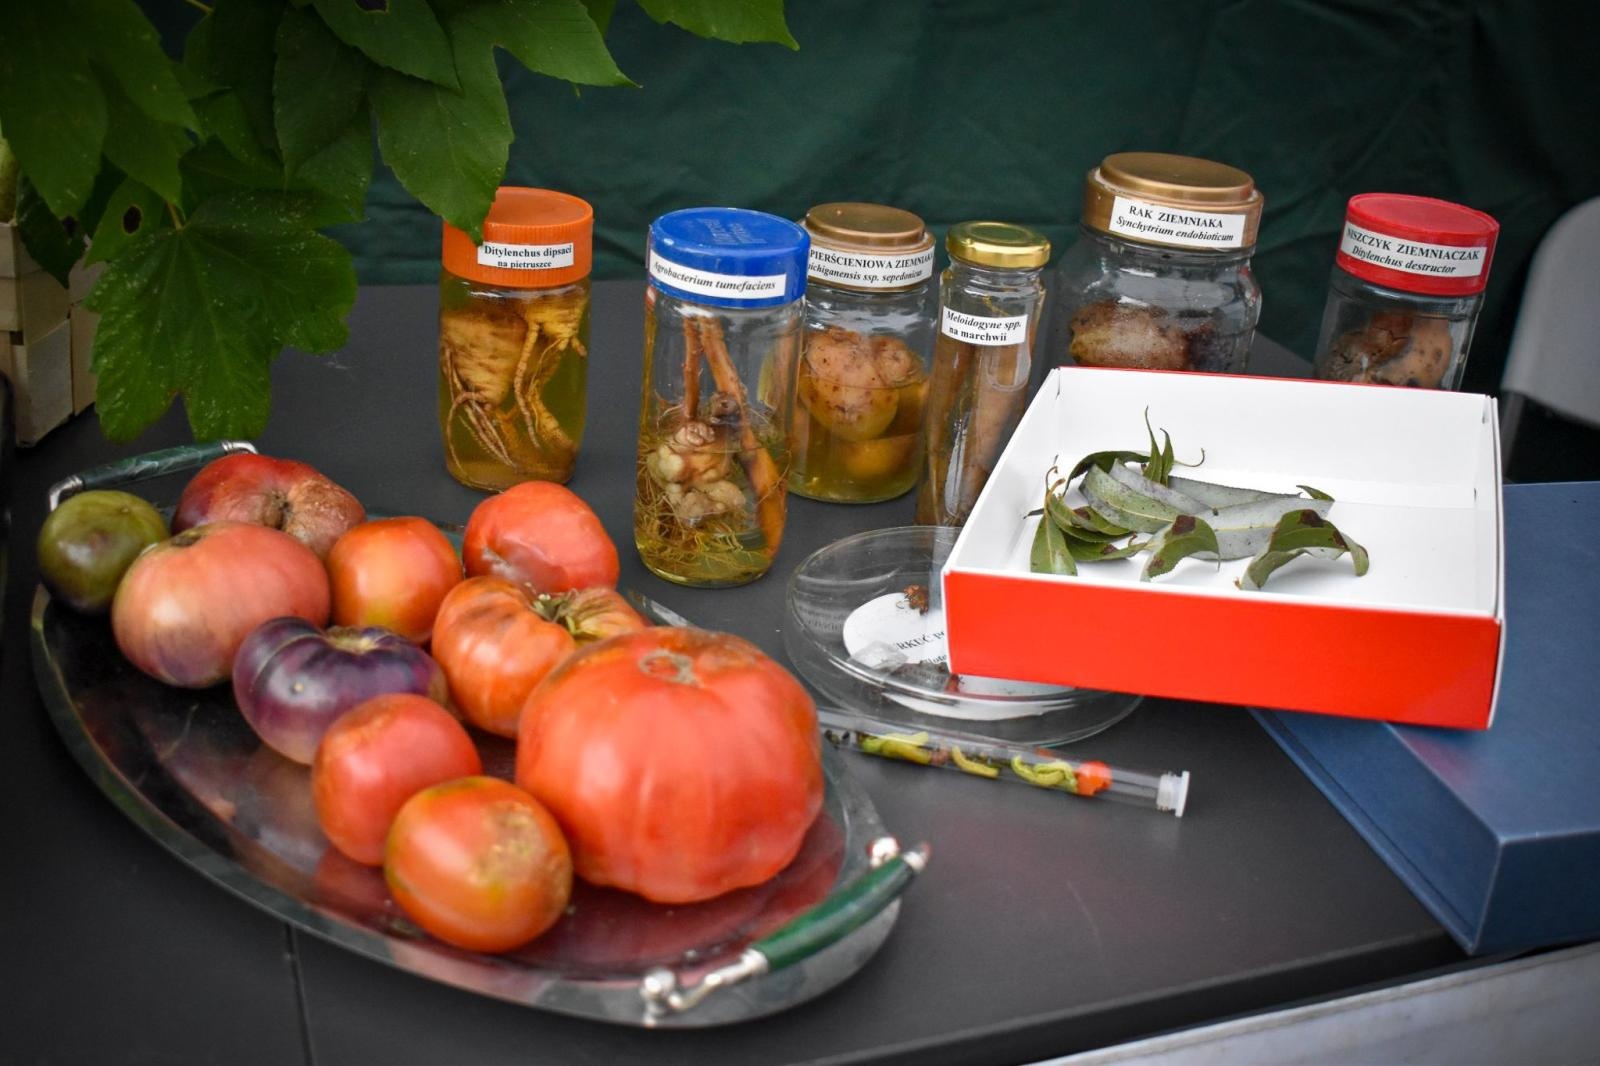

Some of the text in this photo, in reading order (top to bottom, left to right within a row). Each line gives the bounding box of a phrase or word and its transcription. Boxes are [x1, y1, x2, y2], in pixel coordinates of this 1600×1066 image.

[1129, 205, 1223, 228] RAK ZIEMNIAKA
[1116, 216, 1234, 241] Synchytrium endobioticum
[484, 244, 572, 258] Ditylenchus dipsaci
[810, 249, 893, 269] PIERŚCIENIOWA
[1352, 245, 1456, 274] Ditylenchus destructor
[1396, 243, 1481, 260] ZIEMNIACZAK
[510, 260, 552, 268] pietruszce
[653, 261, 776, 293] Agrobacterium tumefaciens
[863, 274, 880, 283] ssp.
[947, 310, 1021, 331] Meloidogyne spp.
[949, 327, 1007, 341] na marchwii
